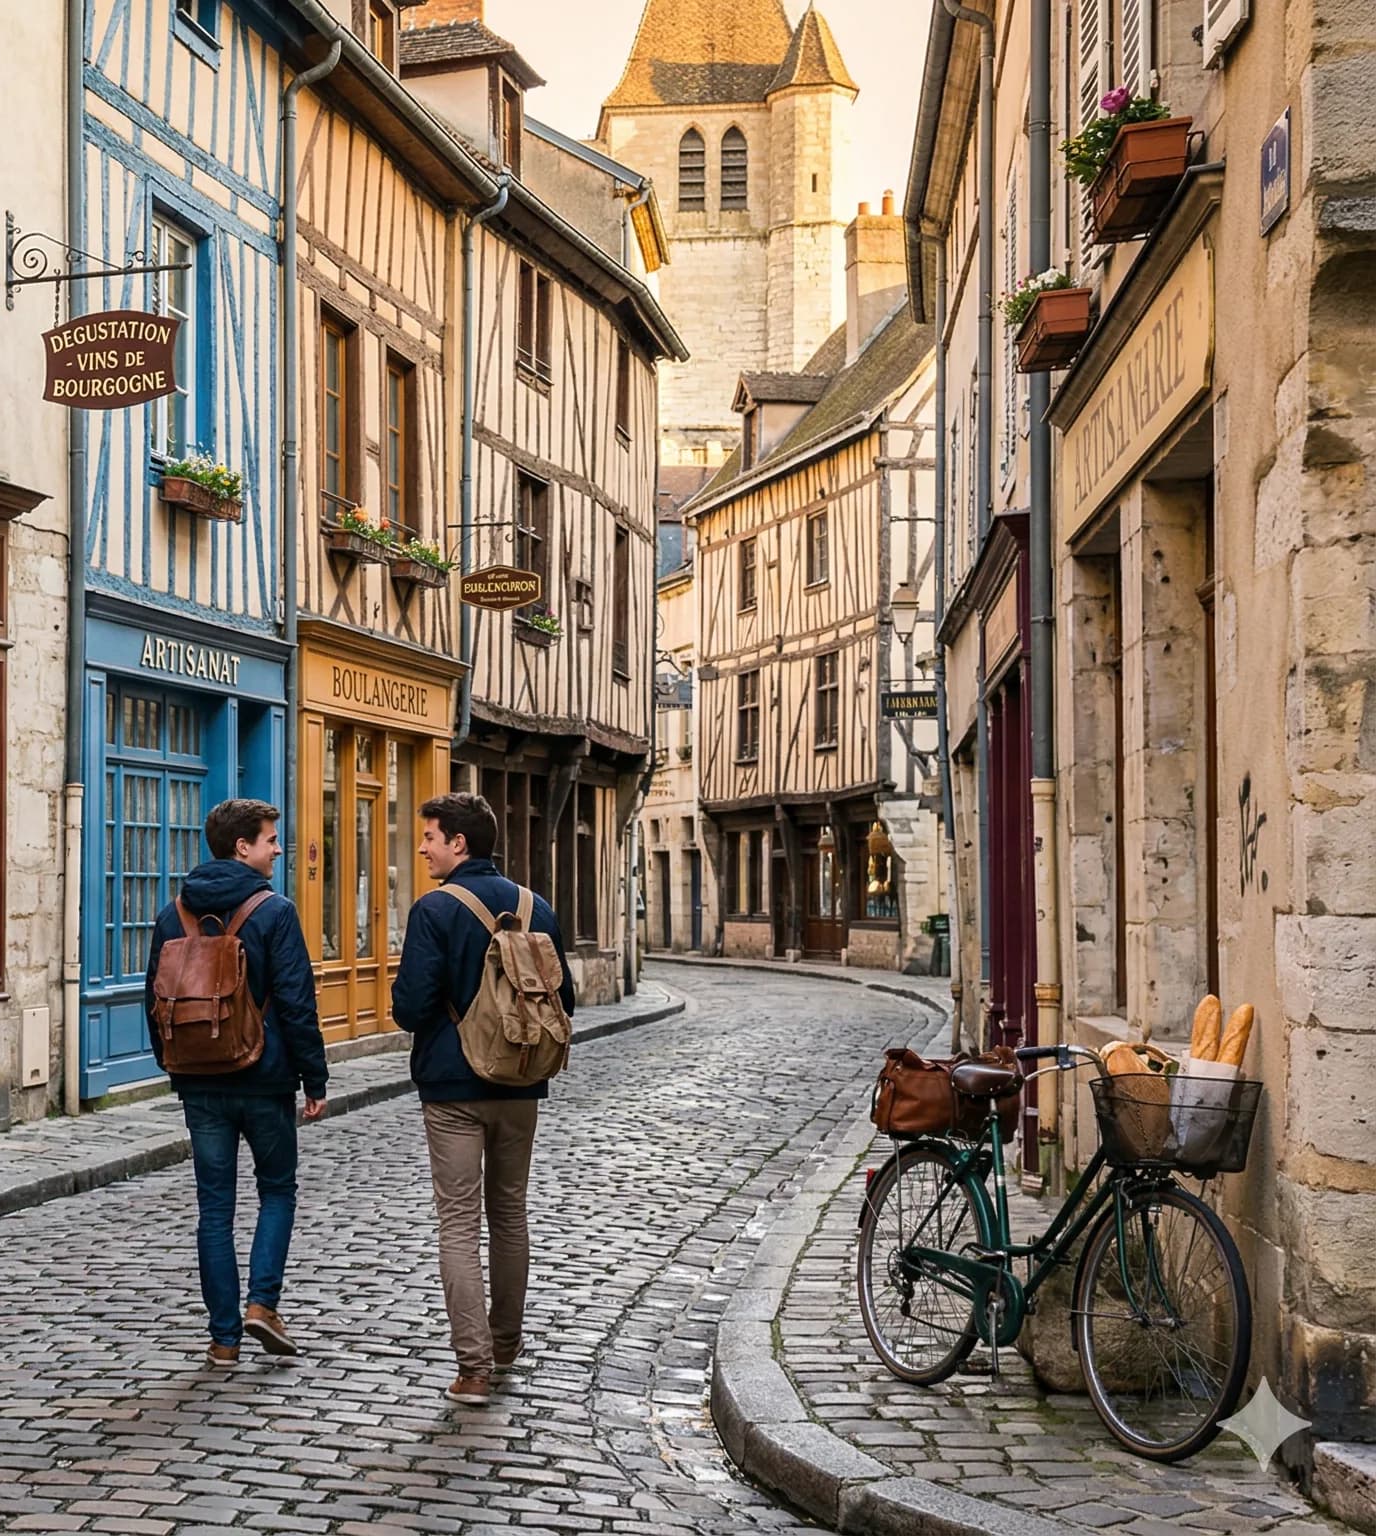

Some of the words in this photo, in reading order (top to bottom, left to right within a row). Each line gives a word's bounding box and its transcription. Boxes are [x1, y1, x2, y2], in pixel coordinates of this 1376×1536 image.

[49, 320, 172, 354] DEGUSTATION
[77, 350, 120, 373] VINS
[125, 349, 145, 368] DE
[53, 370, 168, 399] BOURGOGNE
[140, 633, 242, 686] ARTISANAT
[332, 665, 429, 718] BOULANGERIE
